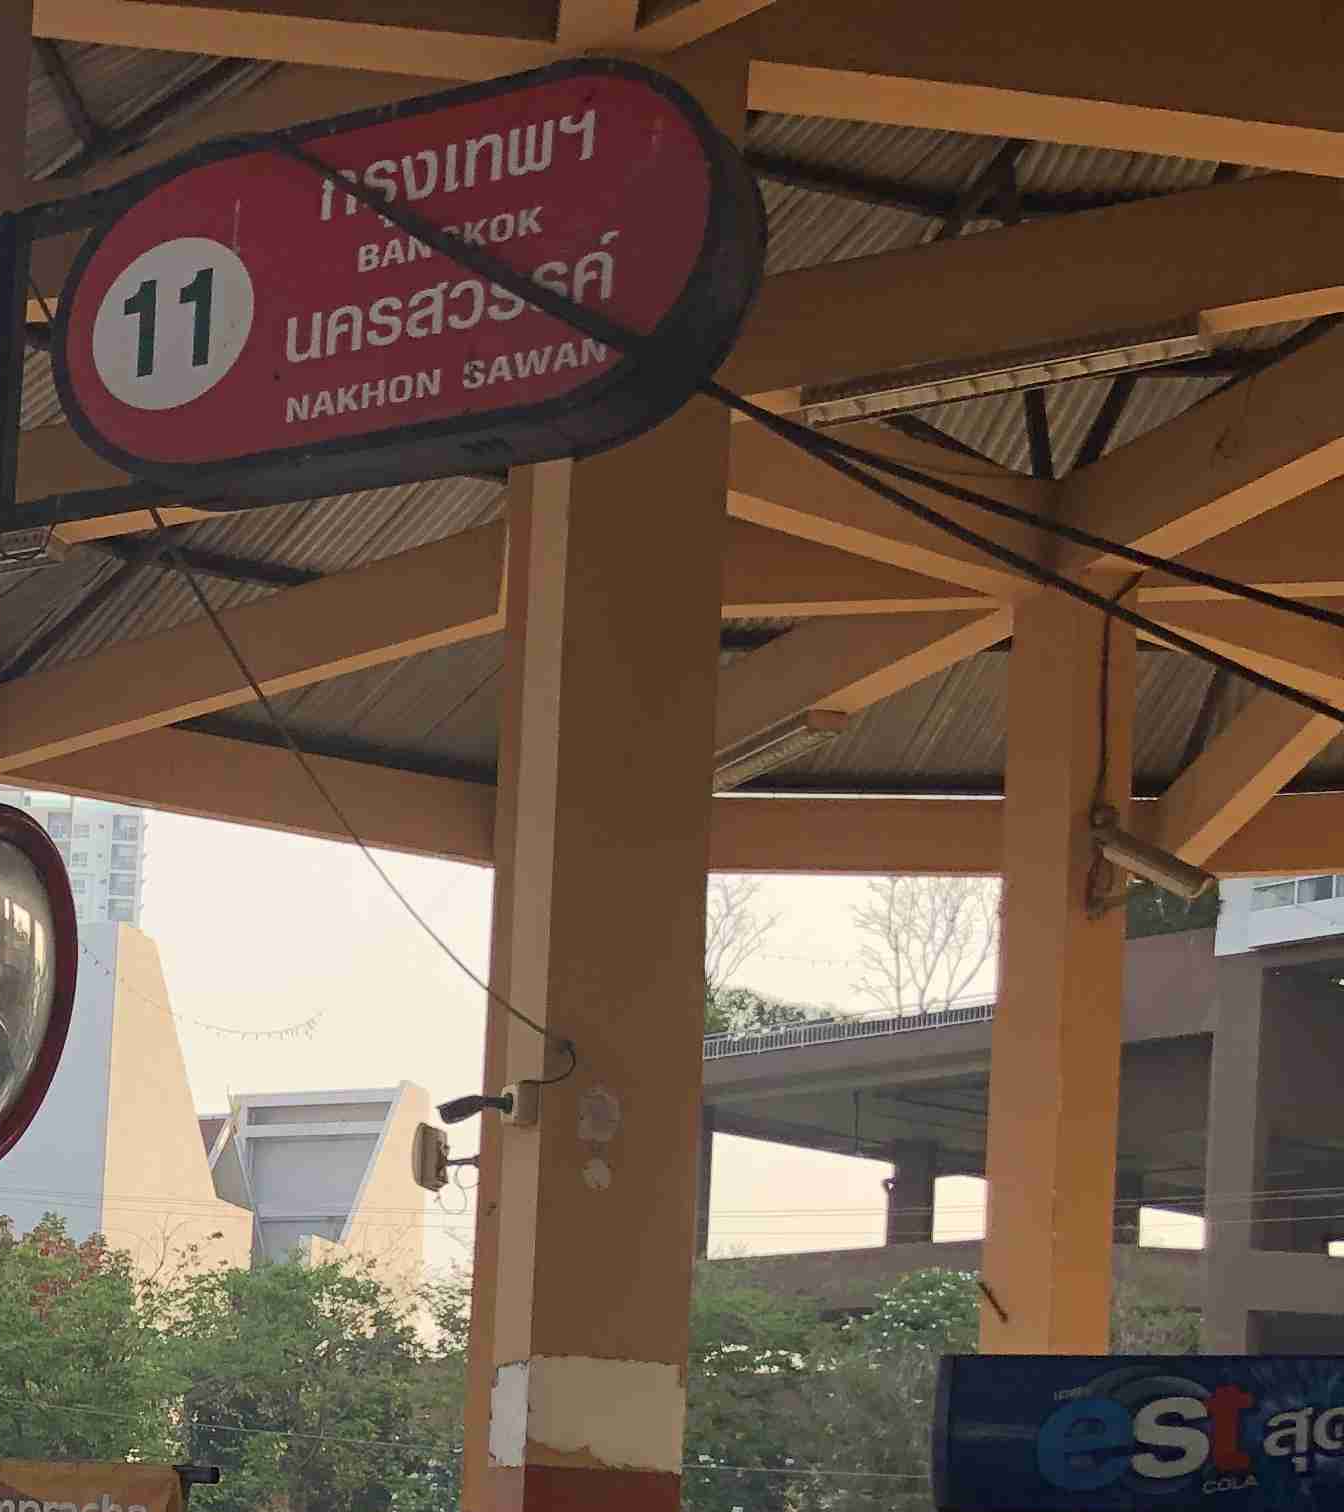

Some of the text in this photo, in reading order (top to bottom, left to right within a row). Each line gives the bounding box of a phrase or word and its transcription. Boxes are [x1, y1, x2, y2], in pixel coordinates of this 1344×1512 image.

[358, 206, 544, 273] BANKOK
[124, 267, 215, 379] 11
[285, 338, 609, 424] NAKHON SAWAN
[1038, 1383, 1255, 1492] est
[1201, 1474, 1258, 1495] COLA
